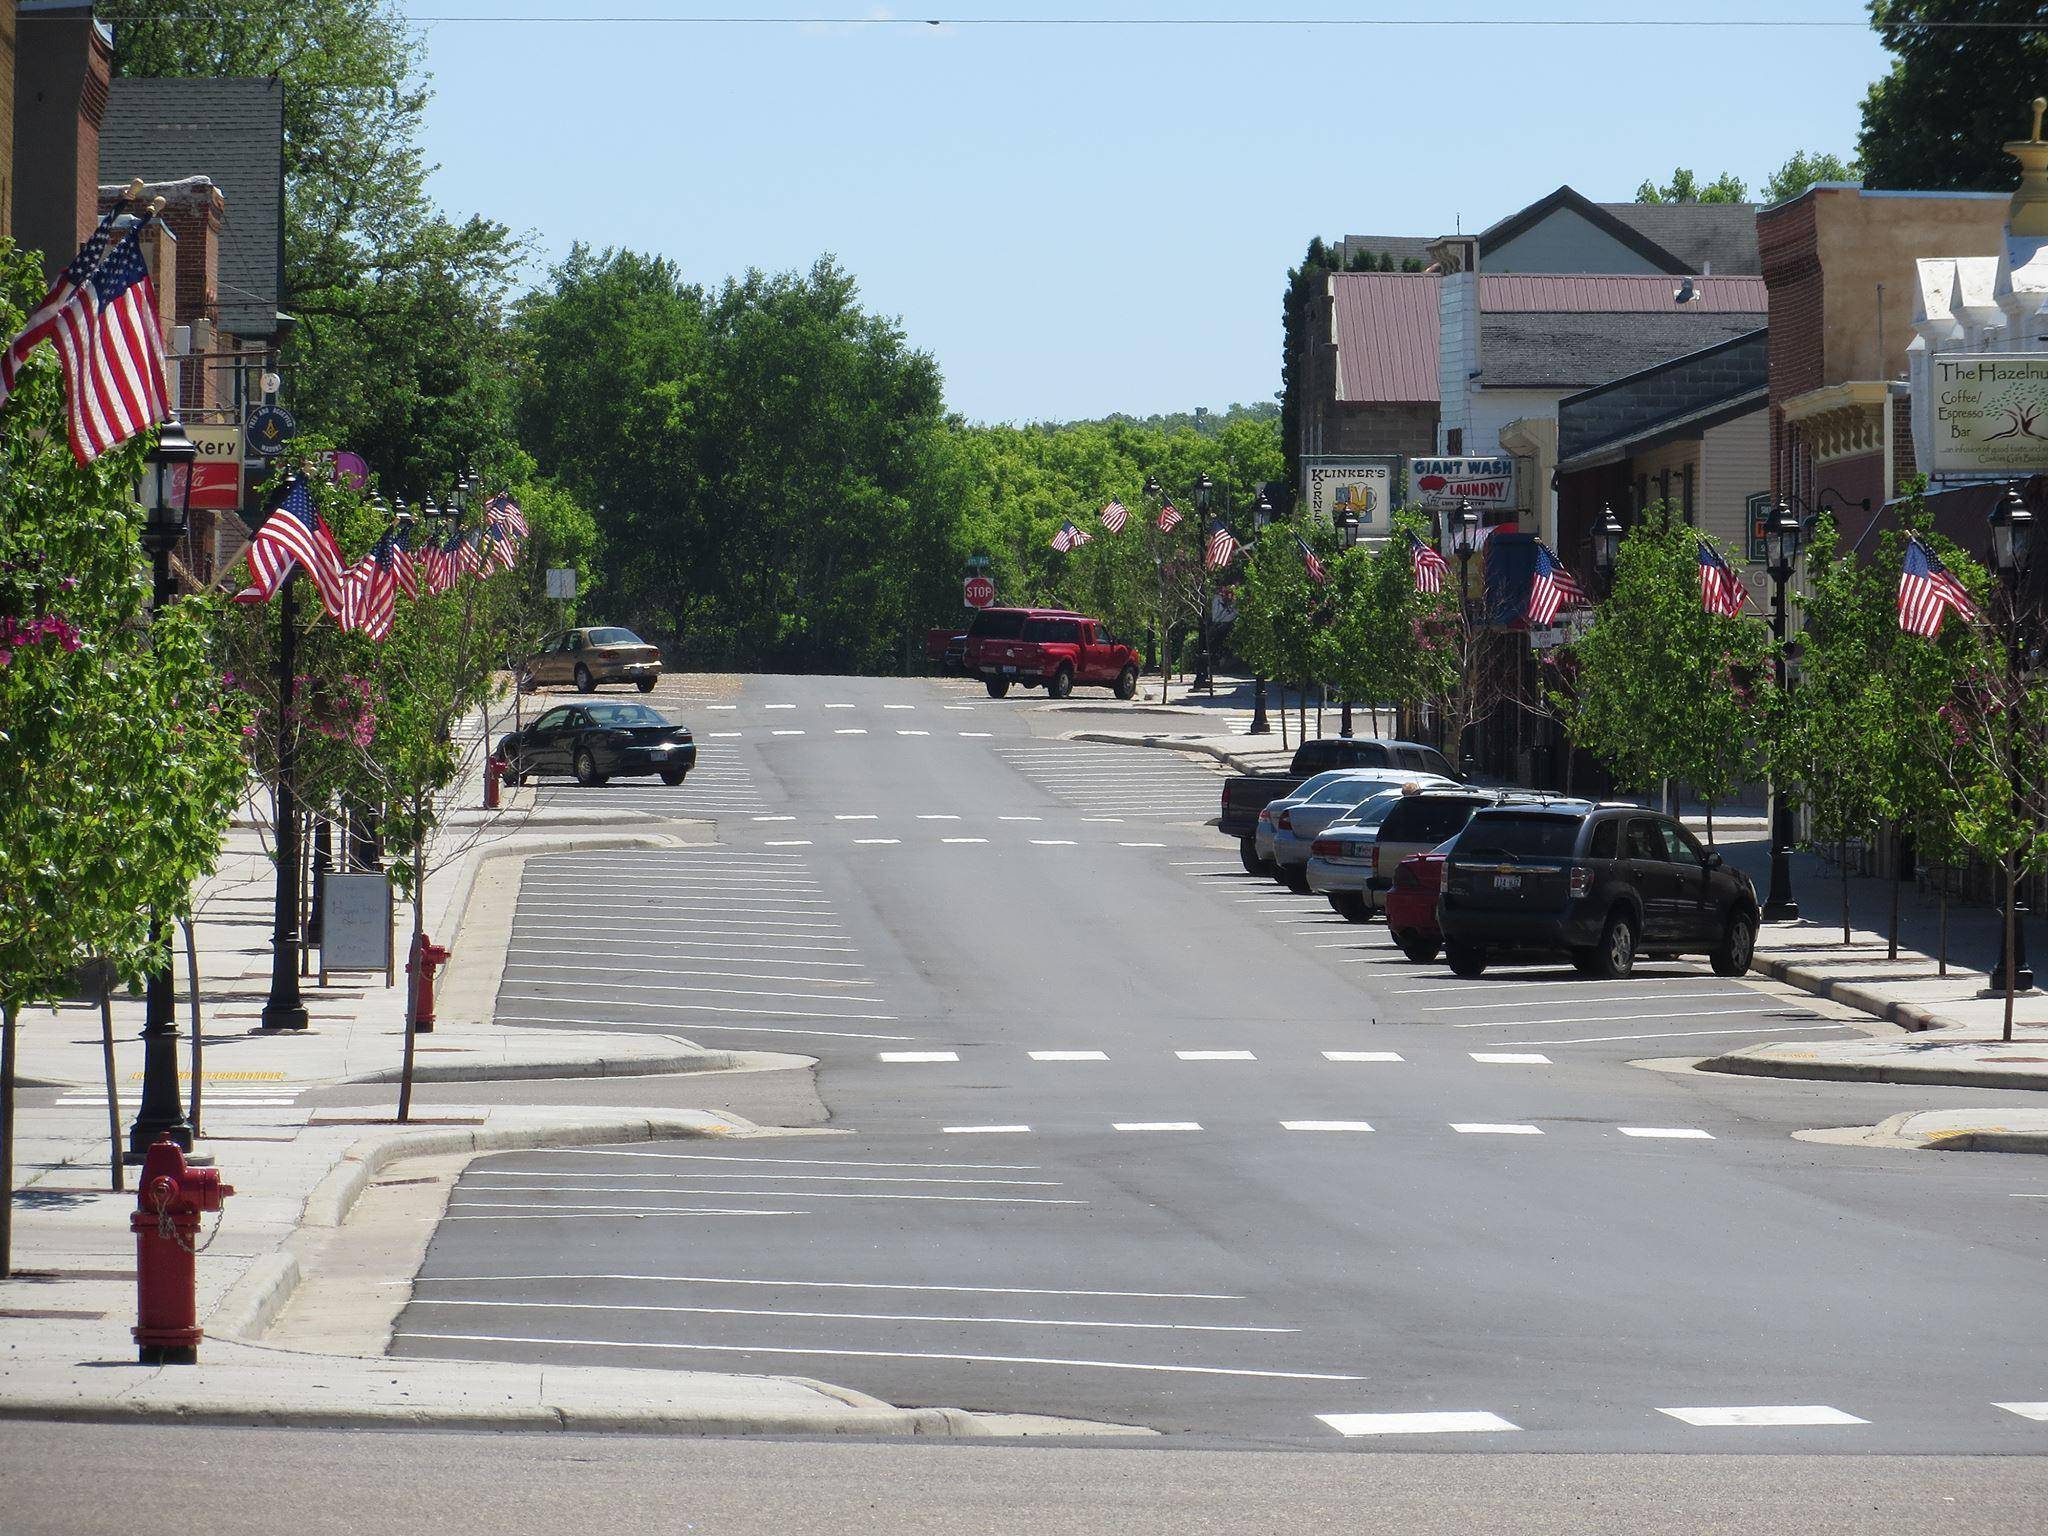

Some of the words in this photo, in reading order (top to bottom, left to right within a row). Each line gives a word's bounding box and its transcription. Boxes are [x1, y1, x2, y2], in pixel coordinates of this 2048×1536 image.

[1937, 363, 1976, 382] The
[1938, 407, 1984, 424] Espresso
[1951, 425, 1971, 438] Bar
[1414, 461, 1463, 475] GIANT
[1468, 461, 1512, 475] WASH
[1311, 469, 1386, 482] KLINKER'S
[1449, 481, 1505, 498] LAUNDRY
[966, 586, 992, 598] STOP
